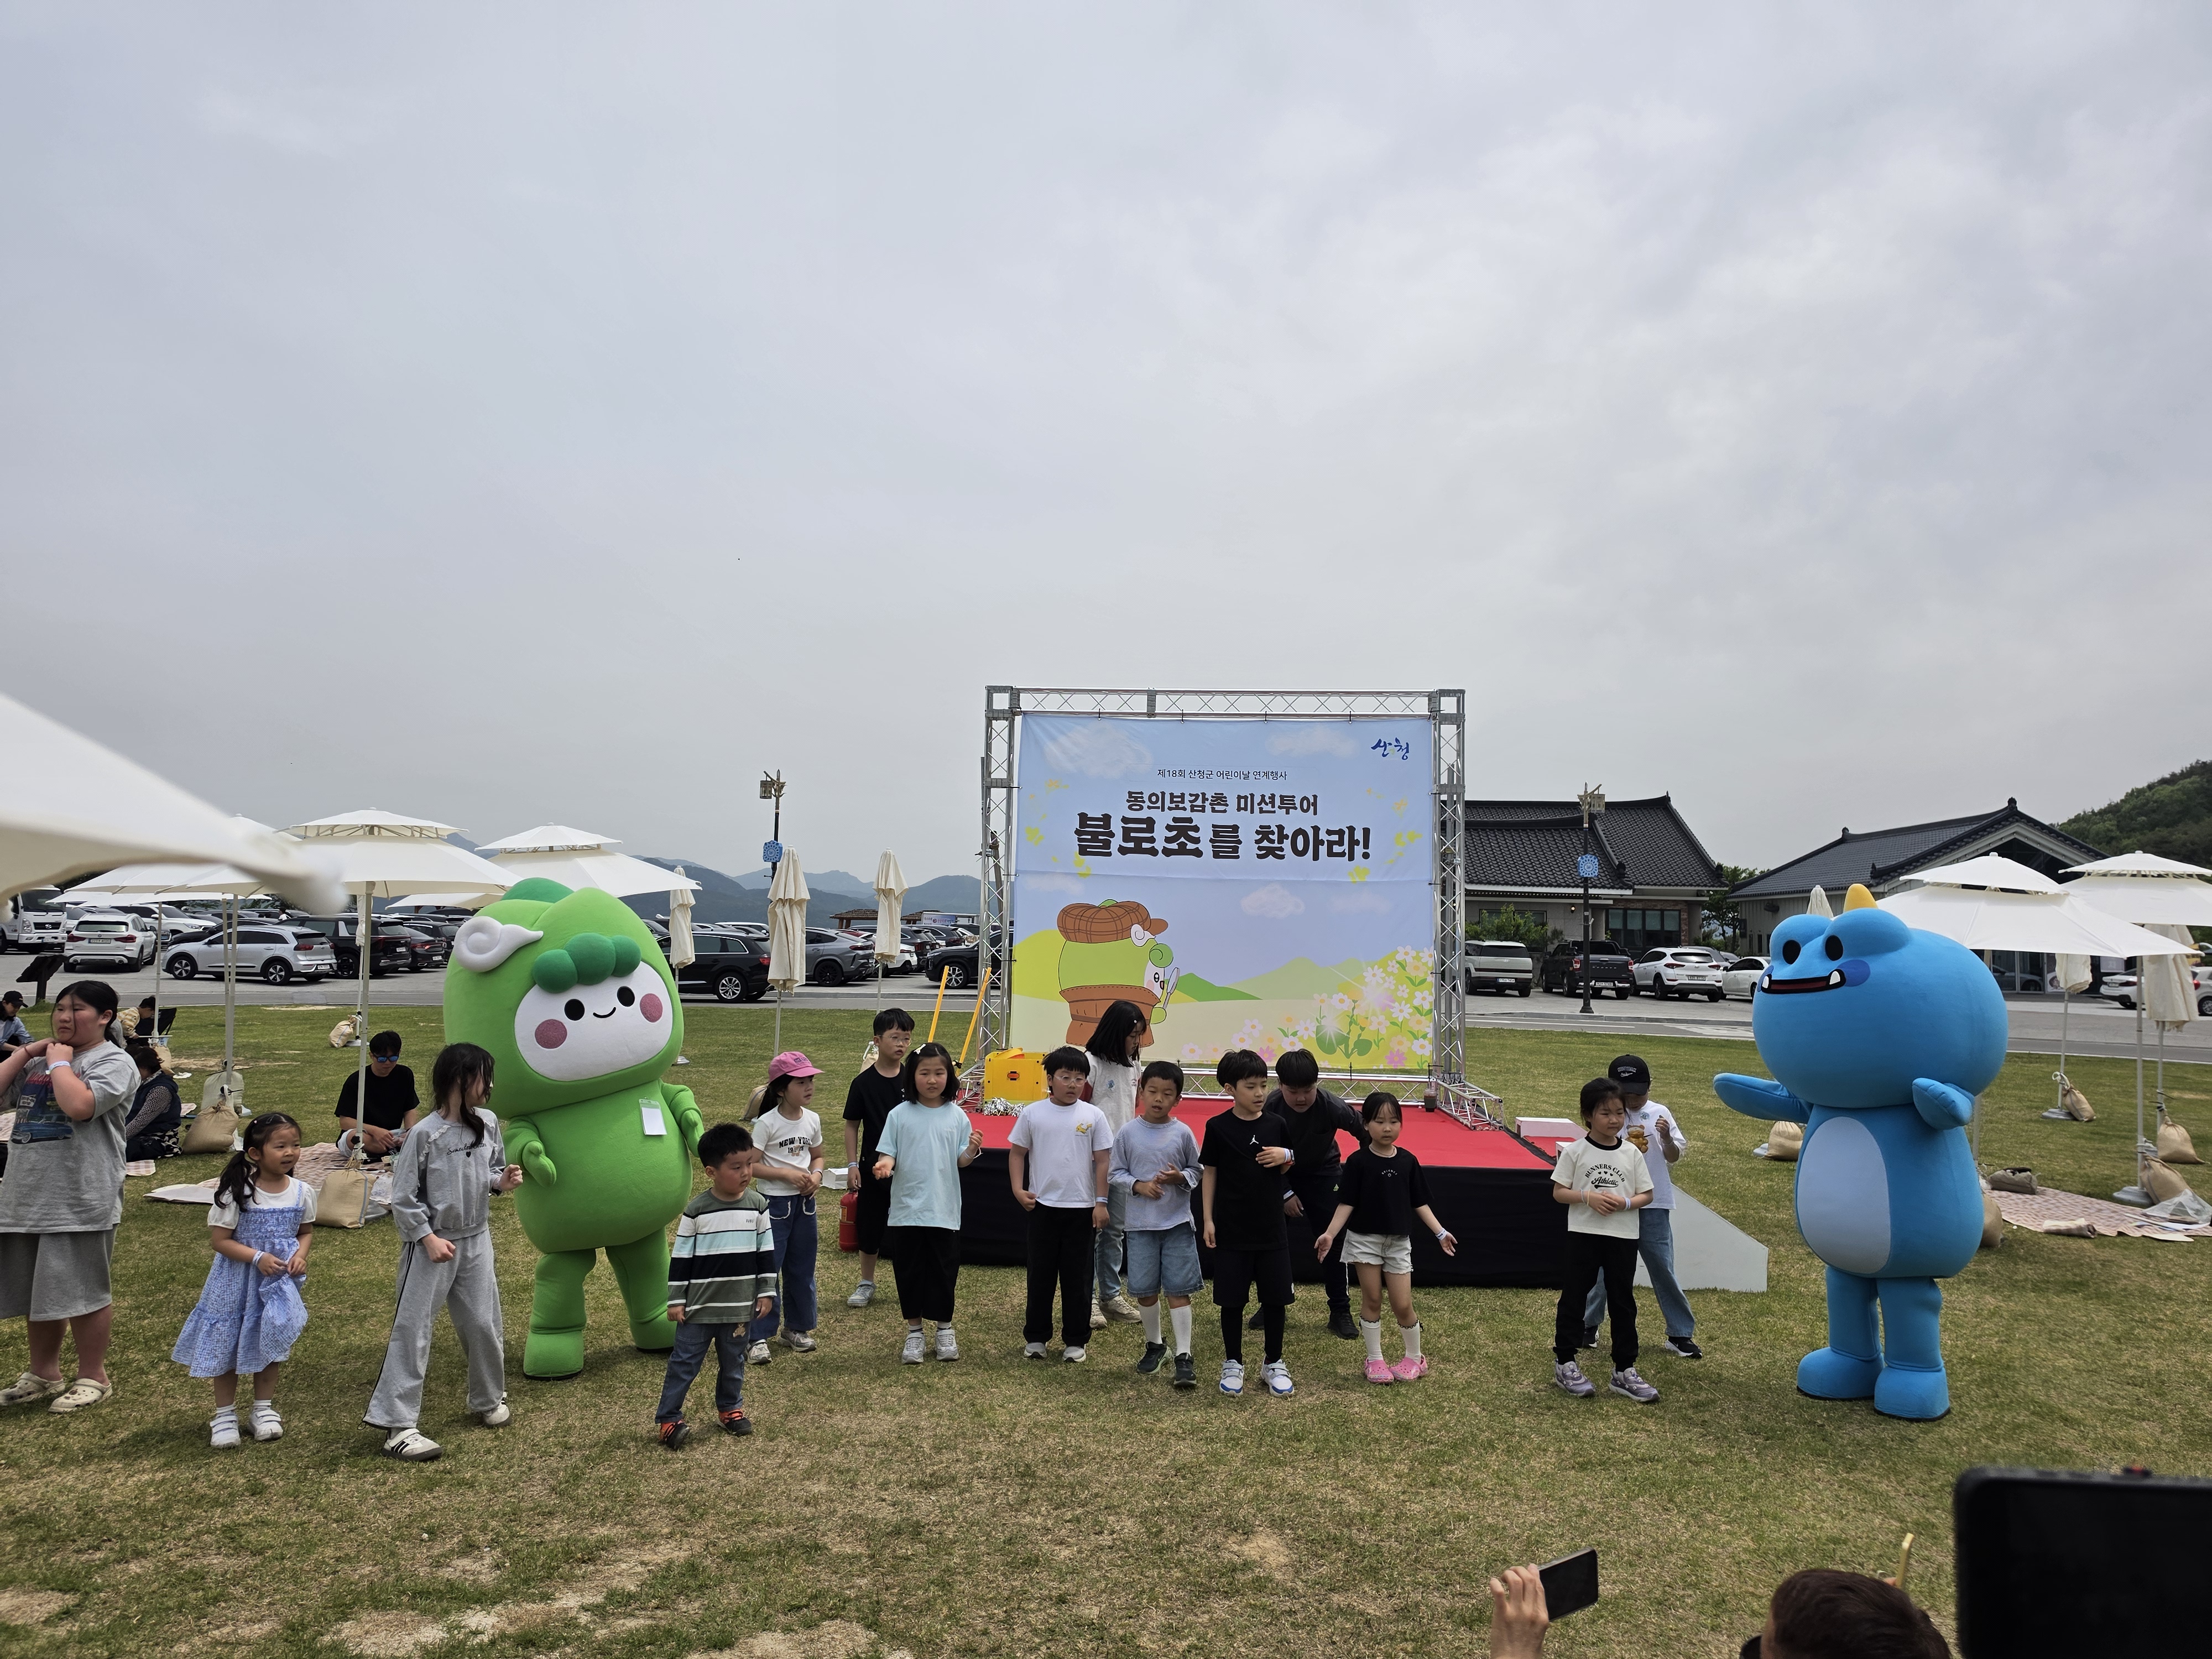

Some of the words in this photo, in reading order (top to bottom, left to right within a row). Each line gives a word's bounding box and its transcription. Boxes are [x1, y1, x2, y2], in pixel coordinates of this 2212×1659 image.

[1370, 737, 1410, 760] 산청
[1157, 769, 1186, 779] 제18회
[1188, 769, 1214, 779] 산청군
[1216, 770, 1251, 780] 어린이날
[1253, 770, 1287, 780] 연계행사
[1126, 790, 1229, 813] 동의보감촌
[1236, 792, 1318, 816] 미션투어
[1074, 812, 1242, 859] 불로초를
[1254, 824, 1371, 862] 찾아라!
[779, 1137, 795, 1148] NEW
[1585, 1164, 1611, 1178] RUNNERS
[1613, 1167, 1625, 1182] CLUB
[1591, 1176, 1618, 1185] Athletic
